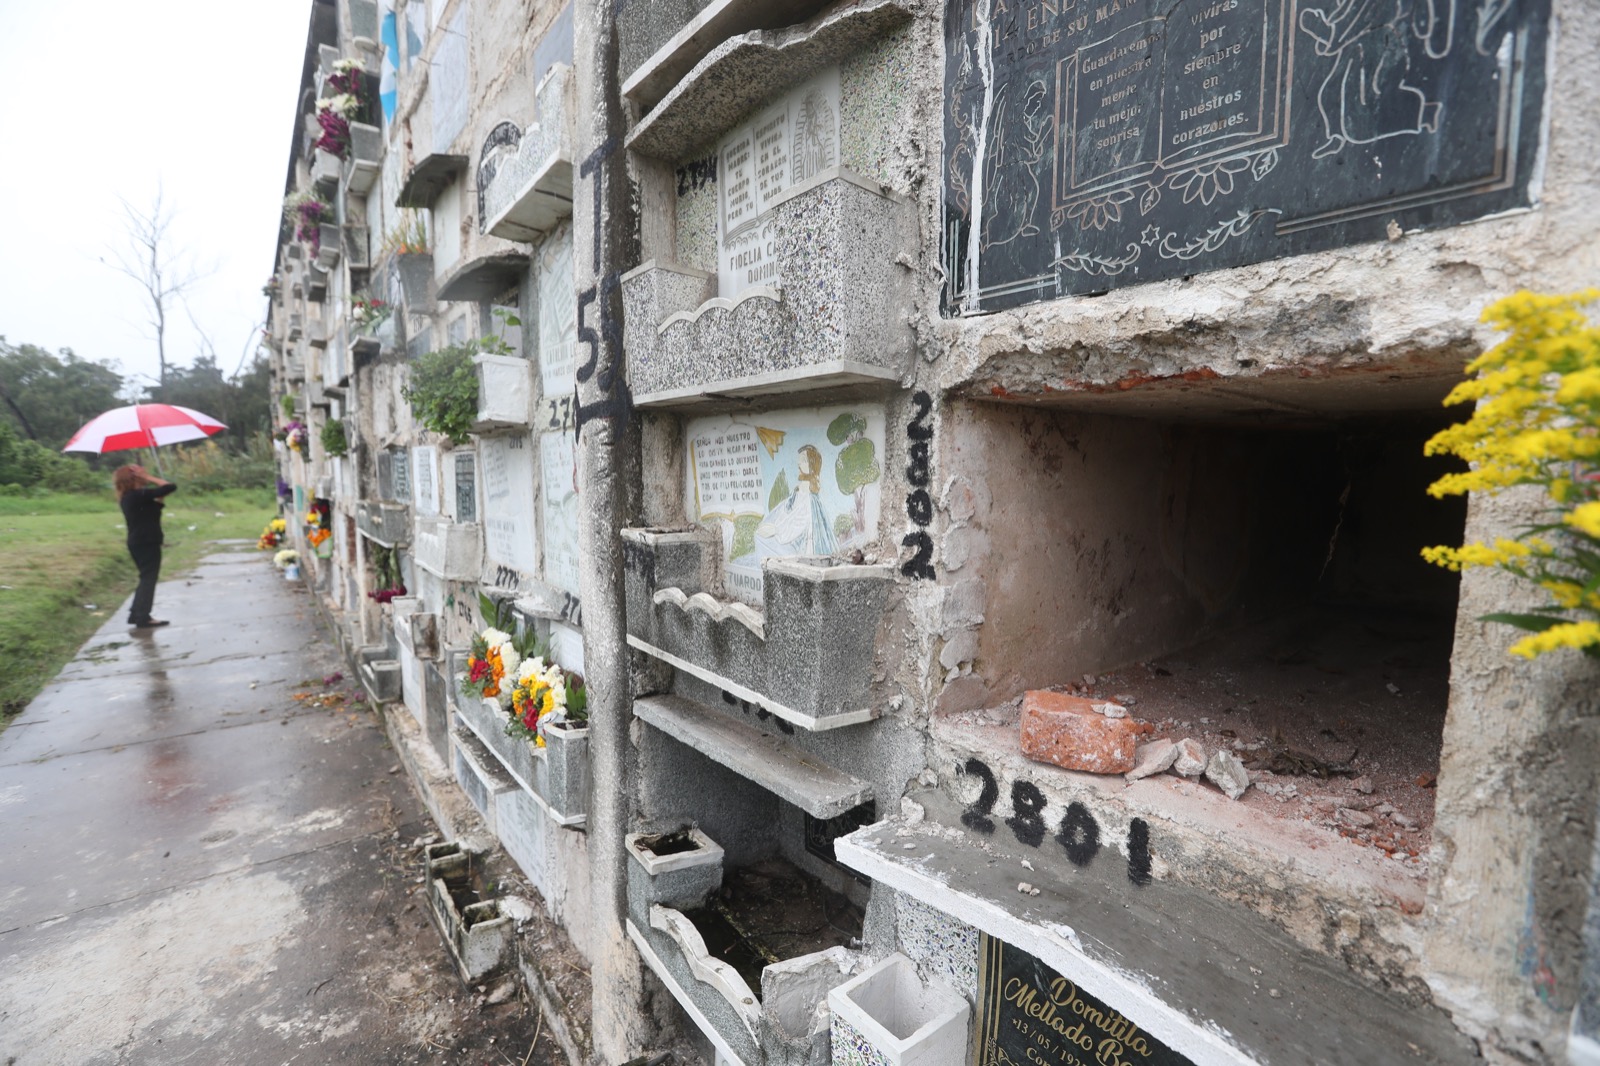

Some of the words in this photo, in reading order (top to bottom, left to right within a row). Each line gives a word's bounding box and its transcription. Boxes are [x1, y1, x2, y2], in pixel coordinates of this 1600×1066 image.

[1067, 14, 1088, 37] SU
[1200, 25, 1227, 49] por
[1183, 43, 1242, 75] siempre
[1090, 78, 1103, 91] en
[1106, 58, 1152, 85] nuestra
[1202, 74, 1219, 89] en
[1101, 84, 1137, 108] mente
[1180, 90, 1242, 121] nuestros
[1094, 118, 1106, 130] tu
[1172, 112, 1250, 145] corazones.
[1097, 126, 1140, 150] sonrisa
[760, 152, 769, 164] EN
[773, 145, 782, 157] EL
[727, 177, 750, 197] CUERPO
[760, 179, 768, 191] DE
[770, 169, 784, 183] TUS
[763, 184, 783, 203] HIJOS
[727, 206, 743, 222] PERO
[745, 201, 754, 213] TU
[730, 246, 762, 271] FIDELIA
[726, 431, 751, 442] NUESTRO
[747, 443, 757, 451] NOS
[732, 492, 740, 501] EL
[901, 391, 937, 581] 2802
[955, 757, 1152, 887] 2801
[1004, 977, 1093, 1051] Mellado
[1050, 976, 1153, 1057] Domitila
[1037, 1034, 1051, 1050] 05
